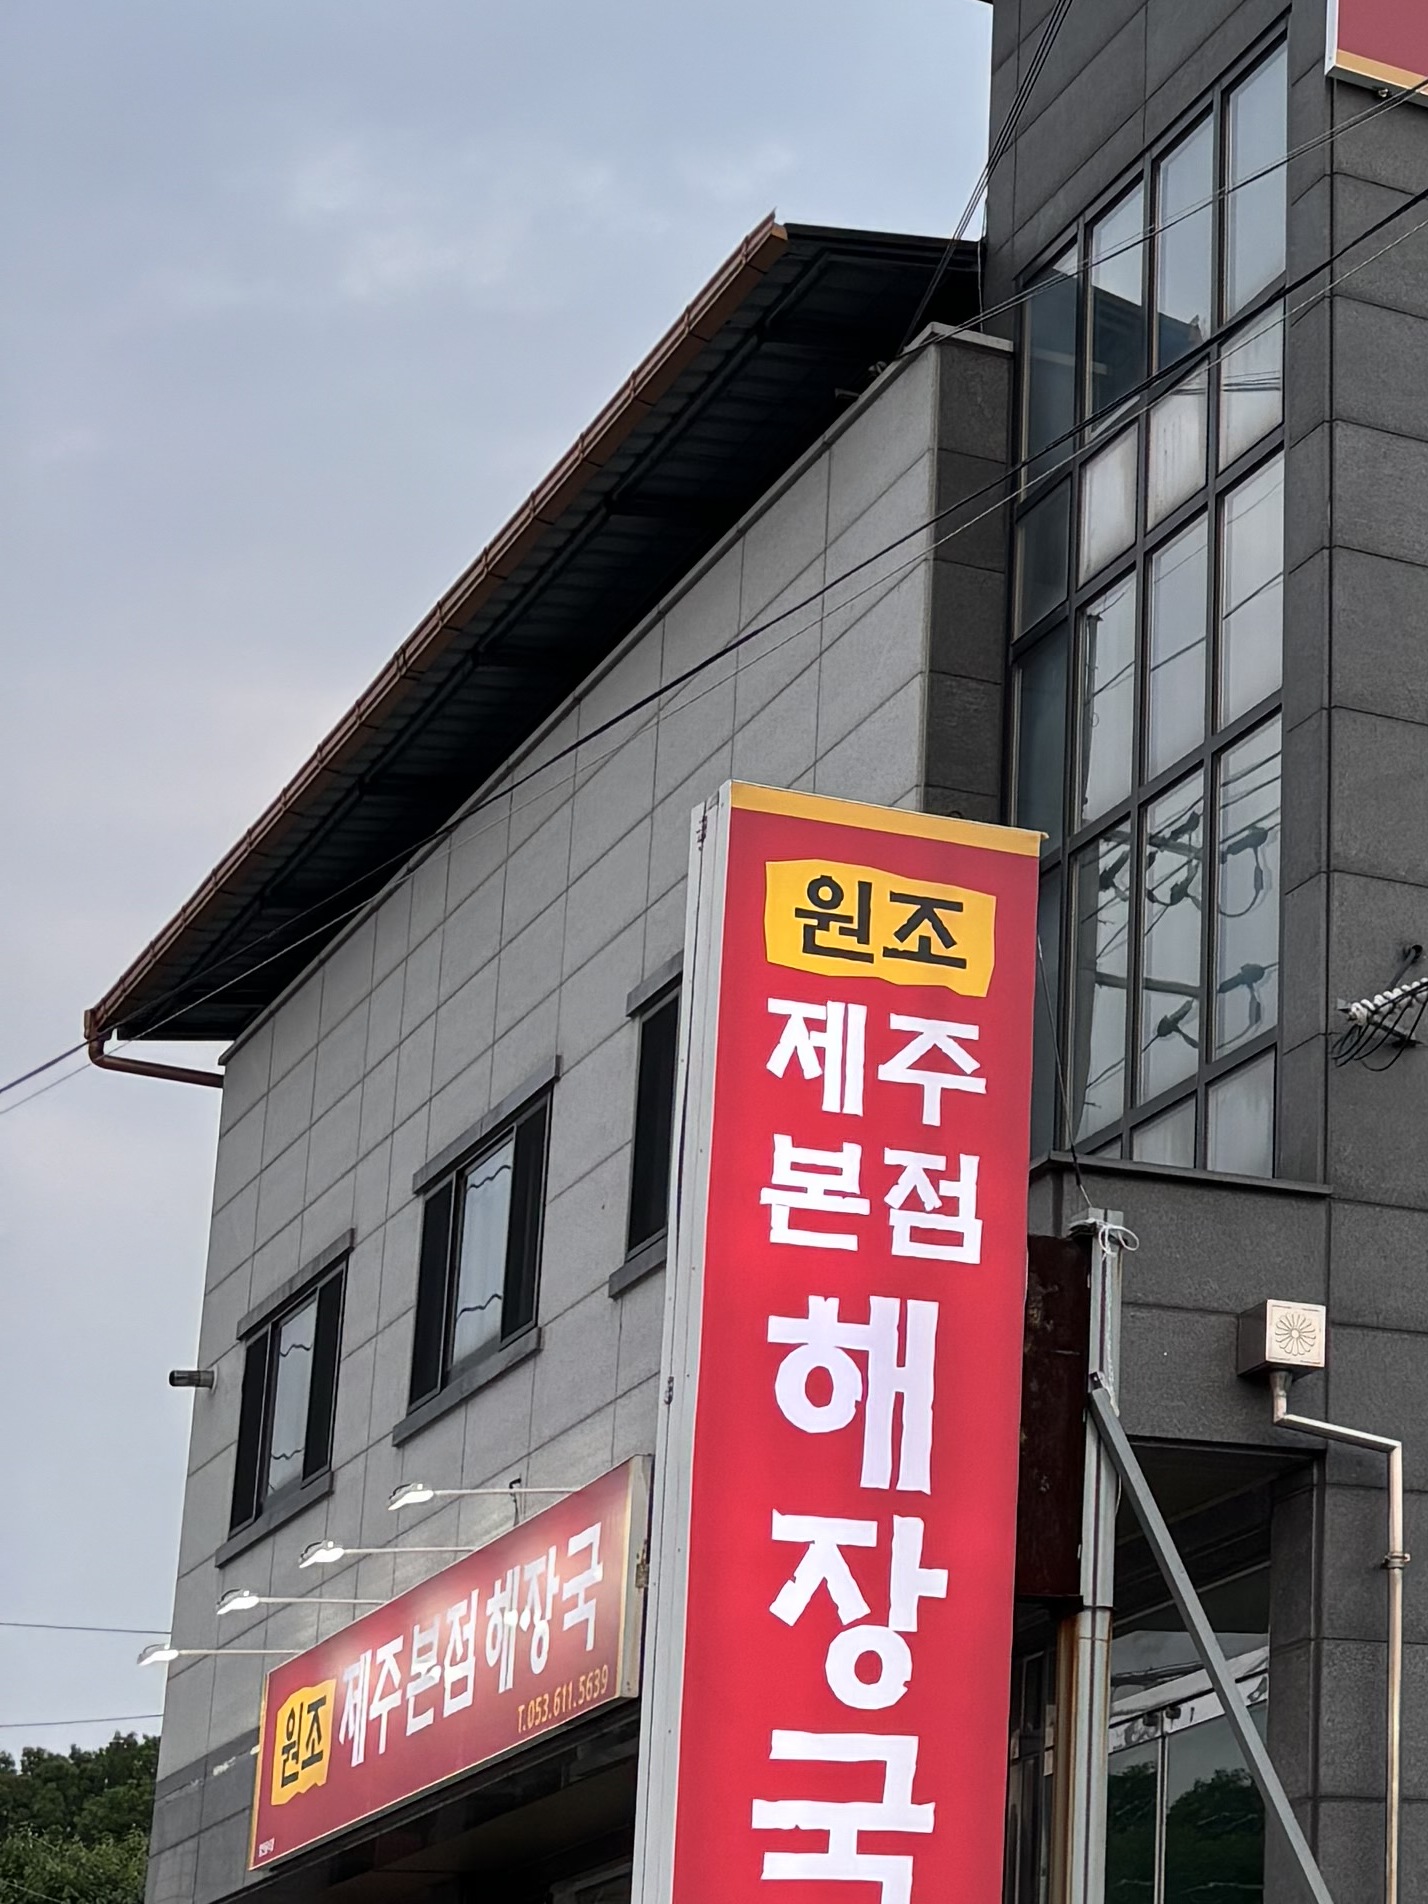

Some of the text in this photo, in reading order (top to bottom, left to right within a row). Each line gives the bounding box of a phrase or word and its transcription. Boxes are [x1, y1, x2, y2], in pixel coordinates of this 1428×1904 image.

[793, 874, 968, 970] 원조
[765, 997, 988, 1127] 제주
[759, 1133, 984, 1265] 본점
[279, 1693, 328, 1789] 원조
[484, 1521, 605, 1694] 해장국
[517, 1663, 609, 1734] T.053.611.5639
